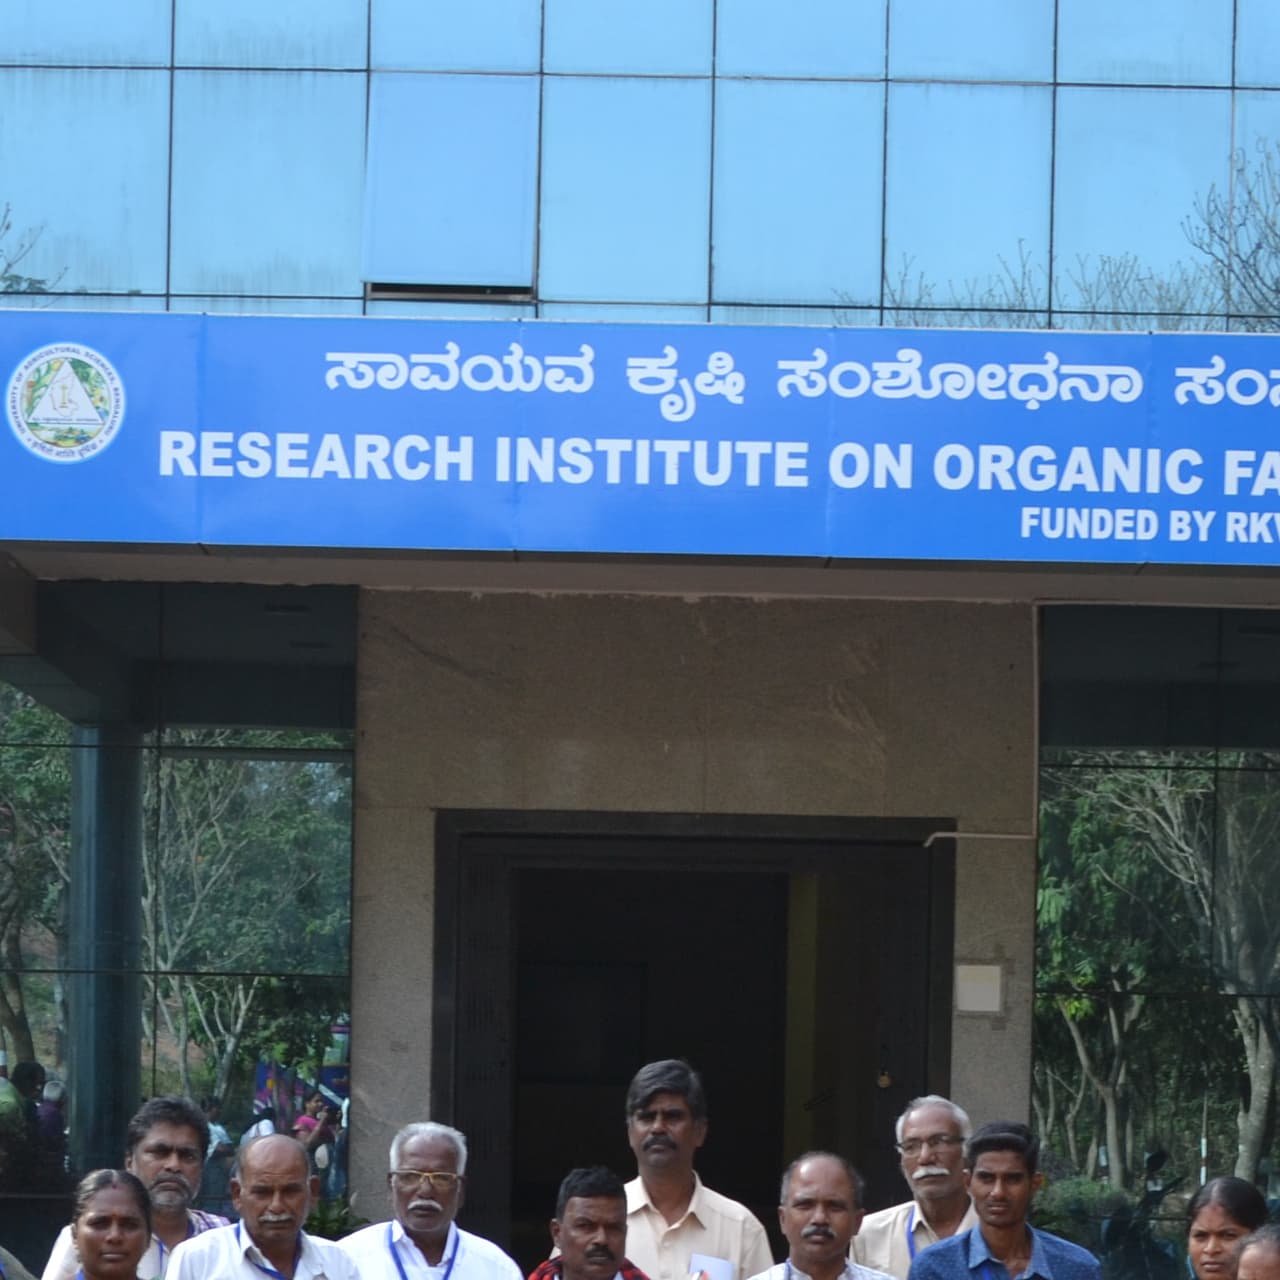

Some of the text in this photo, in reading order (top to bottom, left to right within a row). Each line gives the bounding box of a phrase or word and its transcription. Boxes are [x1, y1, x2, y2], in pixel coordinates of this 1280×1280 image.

[325, 341, 595, 393] ಸಾವಯವ
[626, 345, 746, 422] ಕೃಷಿ
[777, 348, 1143, 410] ಸಂಶೋಧನಾ
[159, 430, 474, 481] RESEARCH
[496, 436, 809, 487] INSTITUTE
[829, 442, 913, 489] ON
[933, 443, 1204, 495] ORGANIC
[1021, 507, 1159, 540] FUNDED
[1170, 510, 1216, 541] BY
